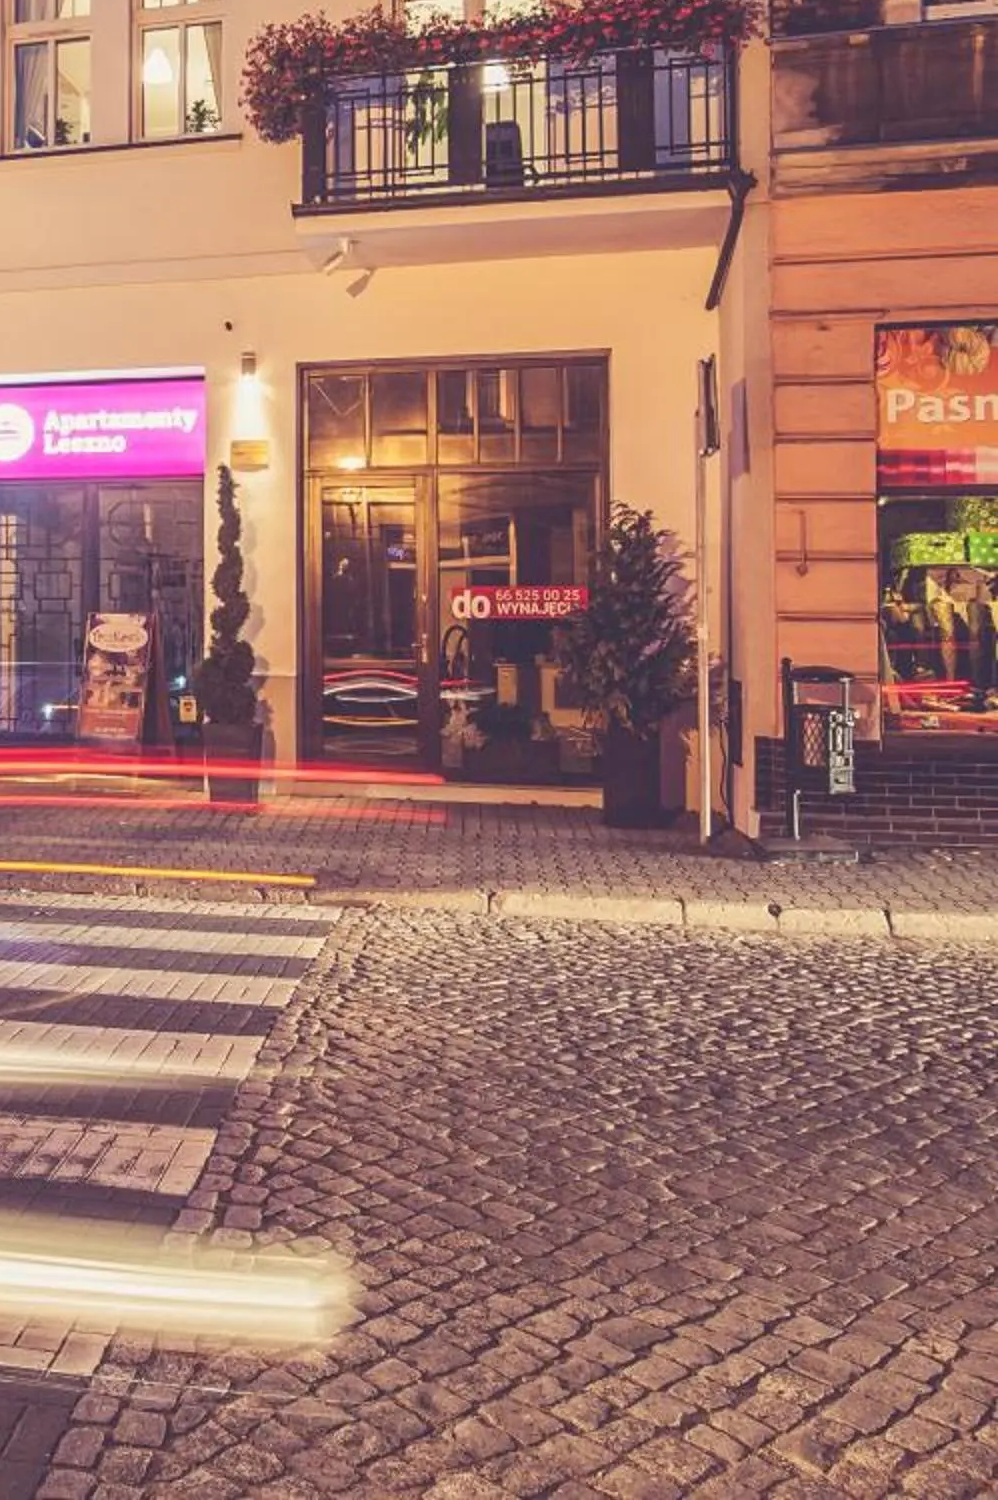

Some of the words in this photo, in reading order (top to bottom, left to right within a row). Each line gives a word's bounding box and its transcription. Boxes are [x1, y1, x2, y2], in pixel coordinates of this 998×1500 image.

[43, 433, 127, 454] Leszno
[452, 589, 491, 619] do
[496, 602, 573, 618] WYNAJĘCI
